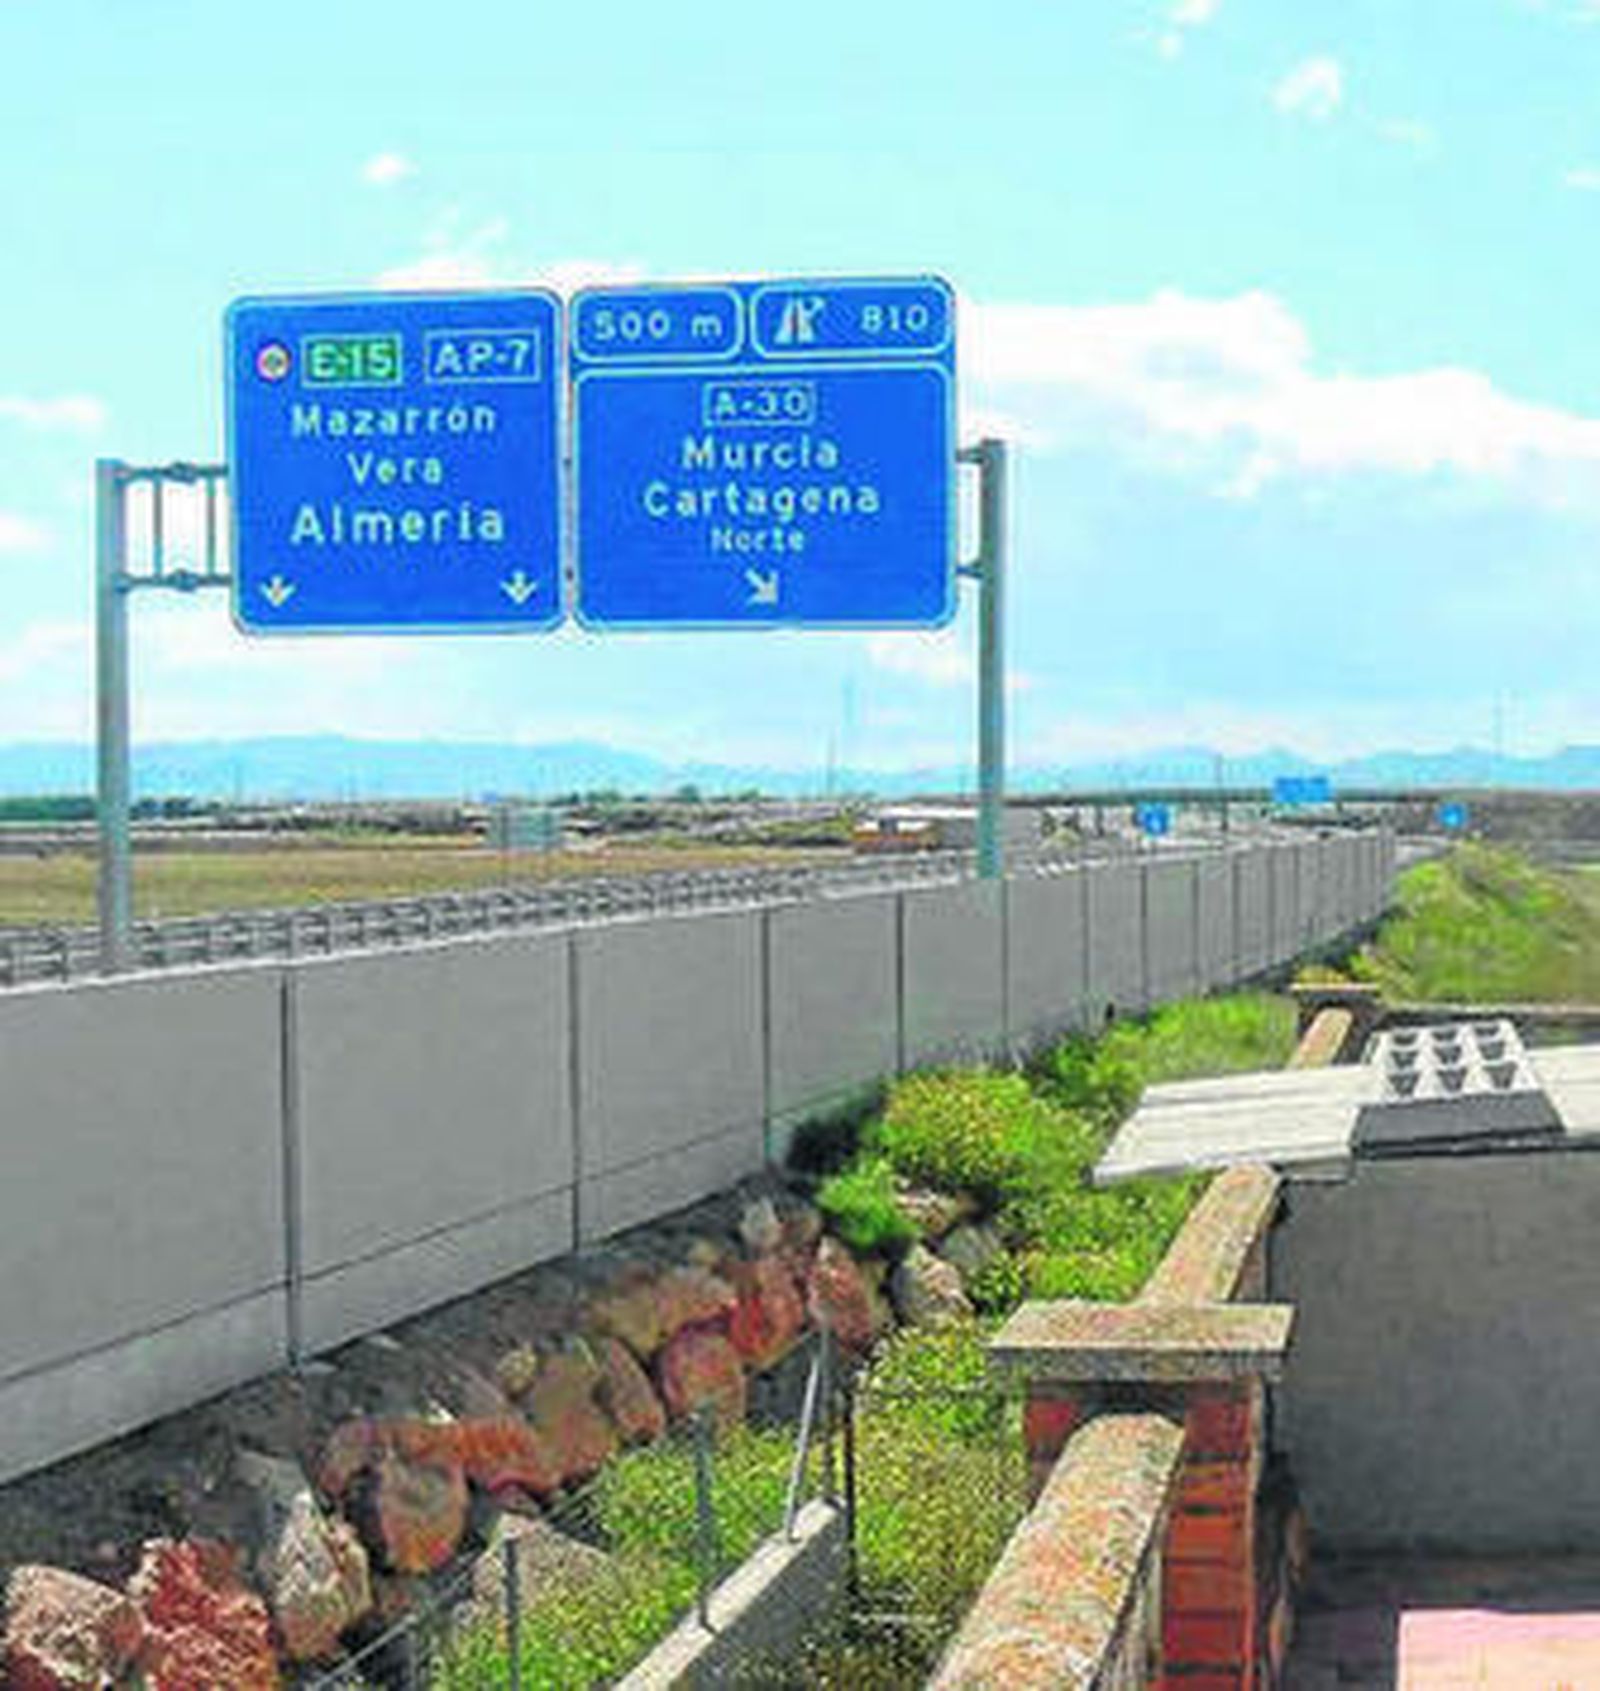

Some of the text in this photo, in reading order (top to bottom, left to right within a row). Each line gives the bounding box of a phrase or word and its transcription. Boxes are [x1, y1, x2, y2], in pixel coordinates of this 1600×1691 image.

[594, 312, 723, 340] 500 m
[433, 339, 529, 374] AP-7
[290, 401, 495, 436] Mazarrón
[713, 390, 806, 418] A-30
[346, 452, 444, 485] Vera
[681, 434, 839, 470] Murcia
[643, 481, 881, 522] Cartagena
[710, 527, 805, 553] Norte
